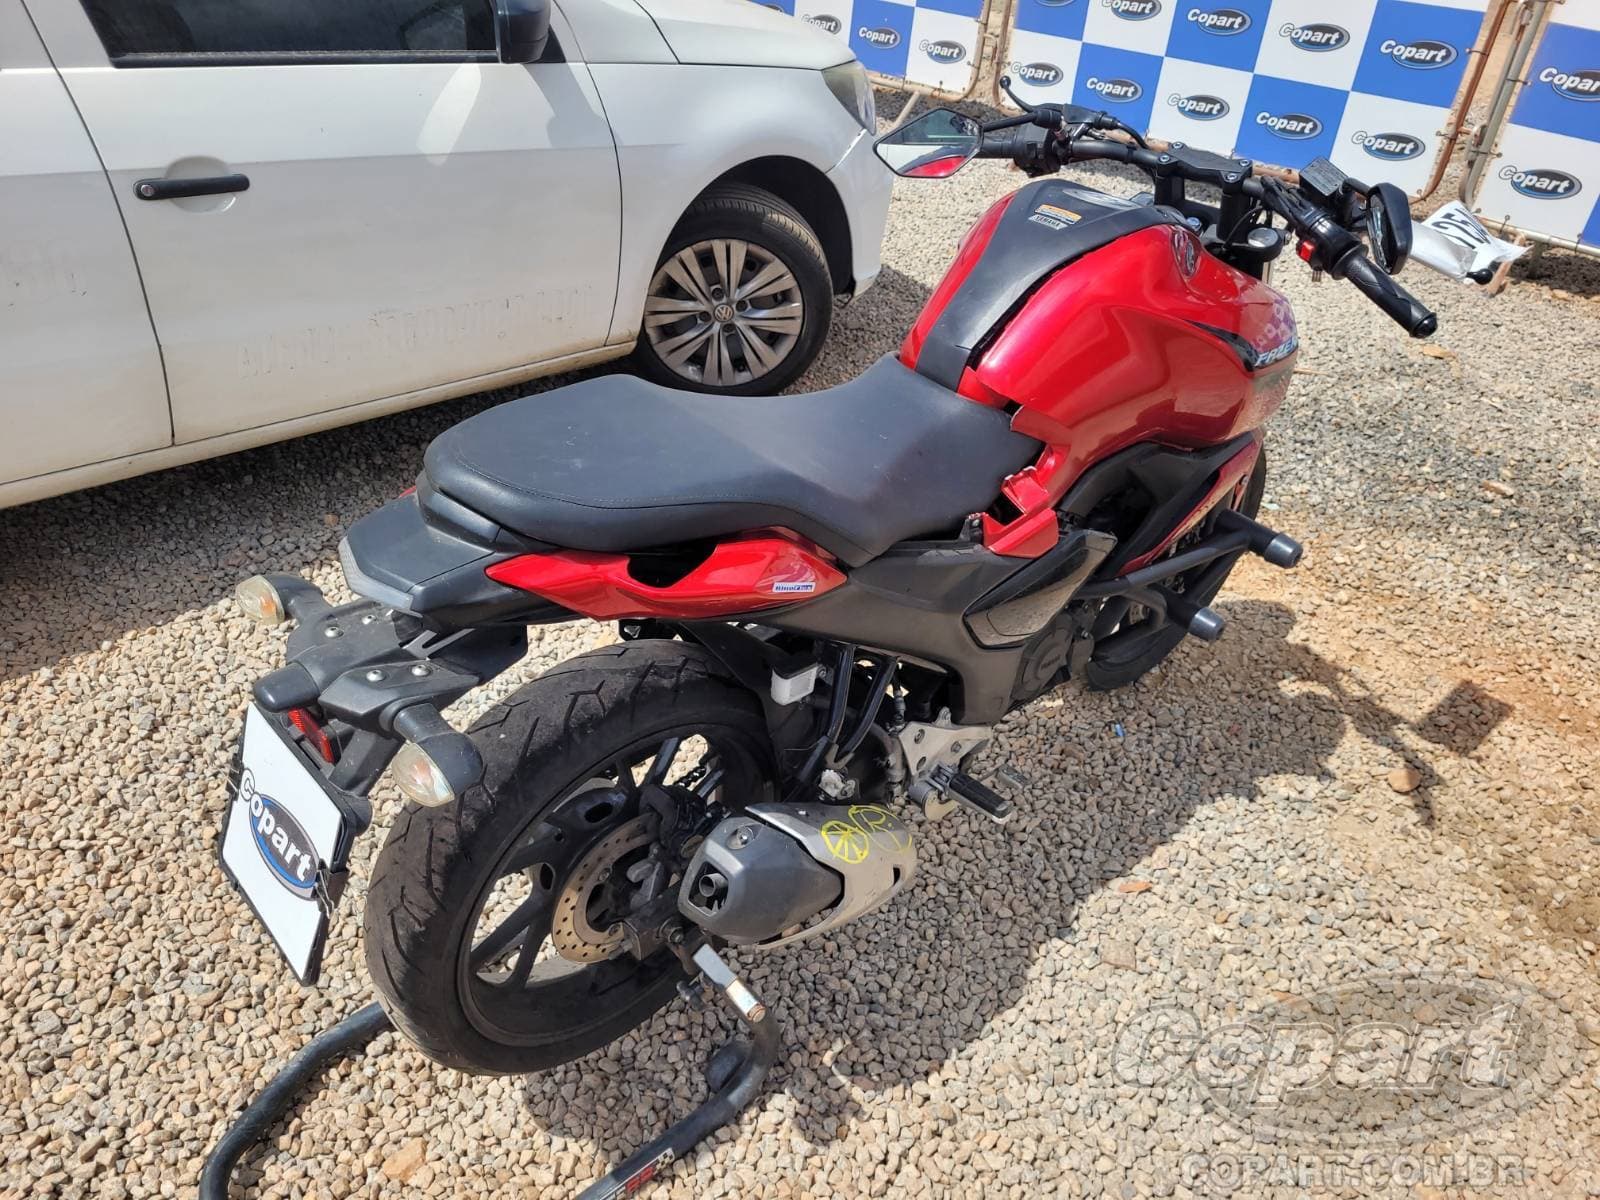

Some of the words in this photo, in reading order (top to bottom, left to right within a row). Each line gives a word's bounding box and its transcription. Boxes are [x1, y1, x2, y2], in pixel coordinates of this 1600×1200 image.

[1101, 0, 1153, 14] Copart
[1187, 8, 1244, 32] Copart
[859, 26, 896, 44] Copart
[1279, 23, 1341, 46] Copart
[919, 39, 960, 58] Copart
[1380, 39, 1449, 63] Copart
[1011, 62, 1057, 82] Copart
[1539, 67, 1600, 92] Copar
[1086, 77, 1136, 98] Copart
[1167, 93, 1222, 116] Copart
[1256, 111, 1315, 135] Copart
[1351, 131, 1417, 155] Copart
[1499, 165, 1570, 194] Copart
[239, 767, 313, 882] Copart
